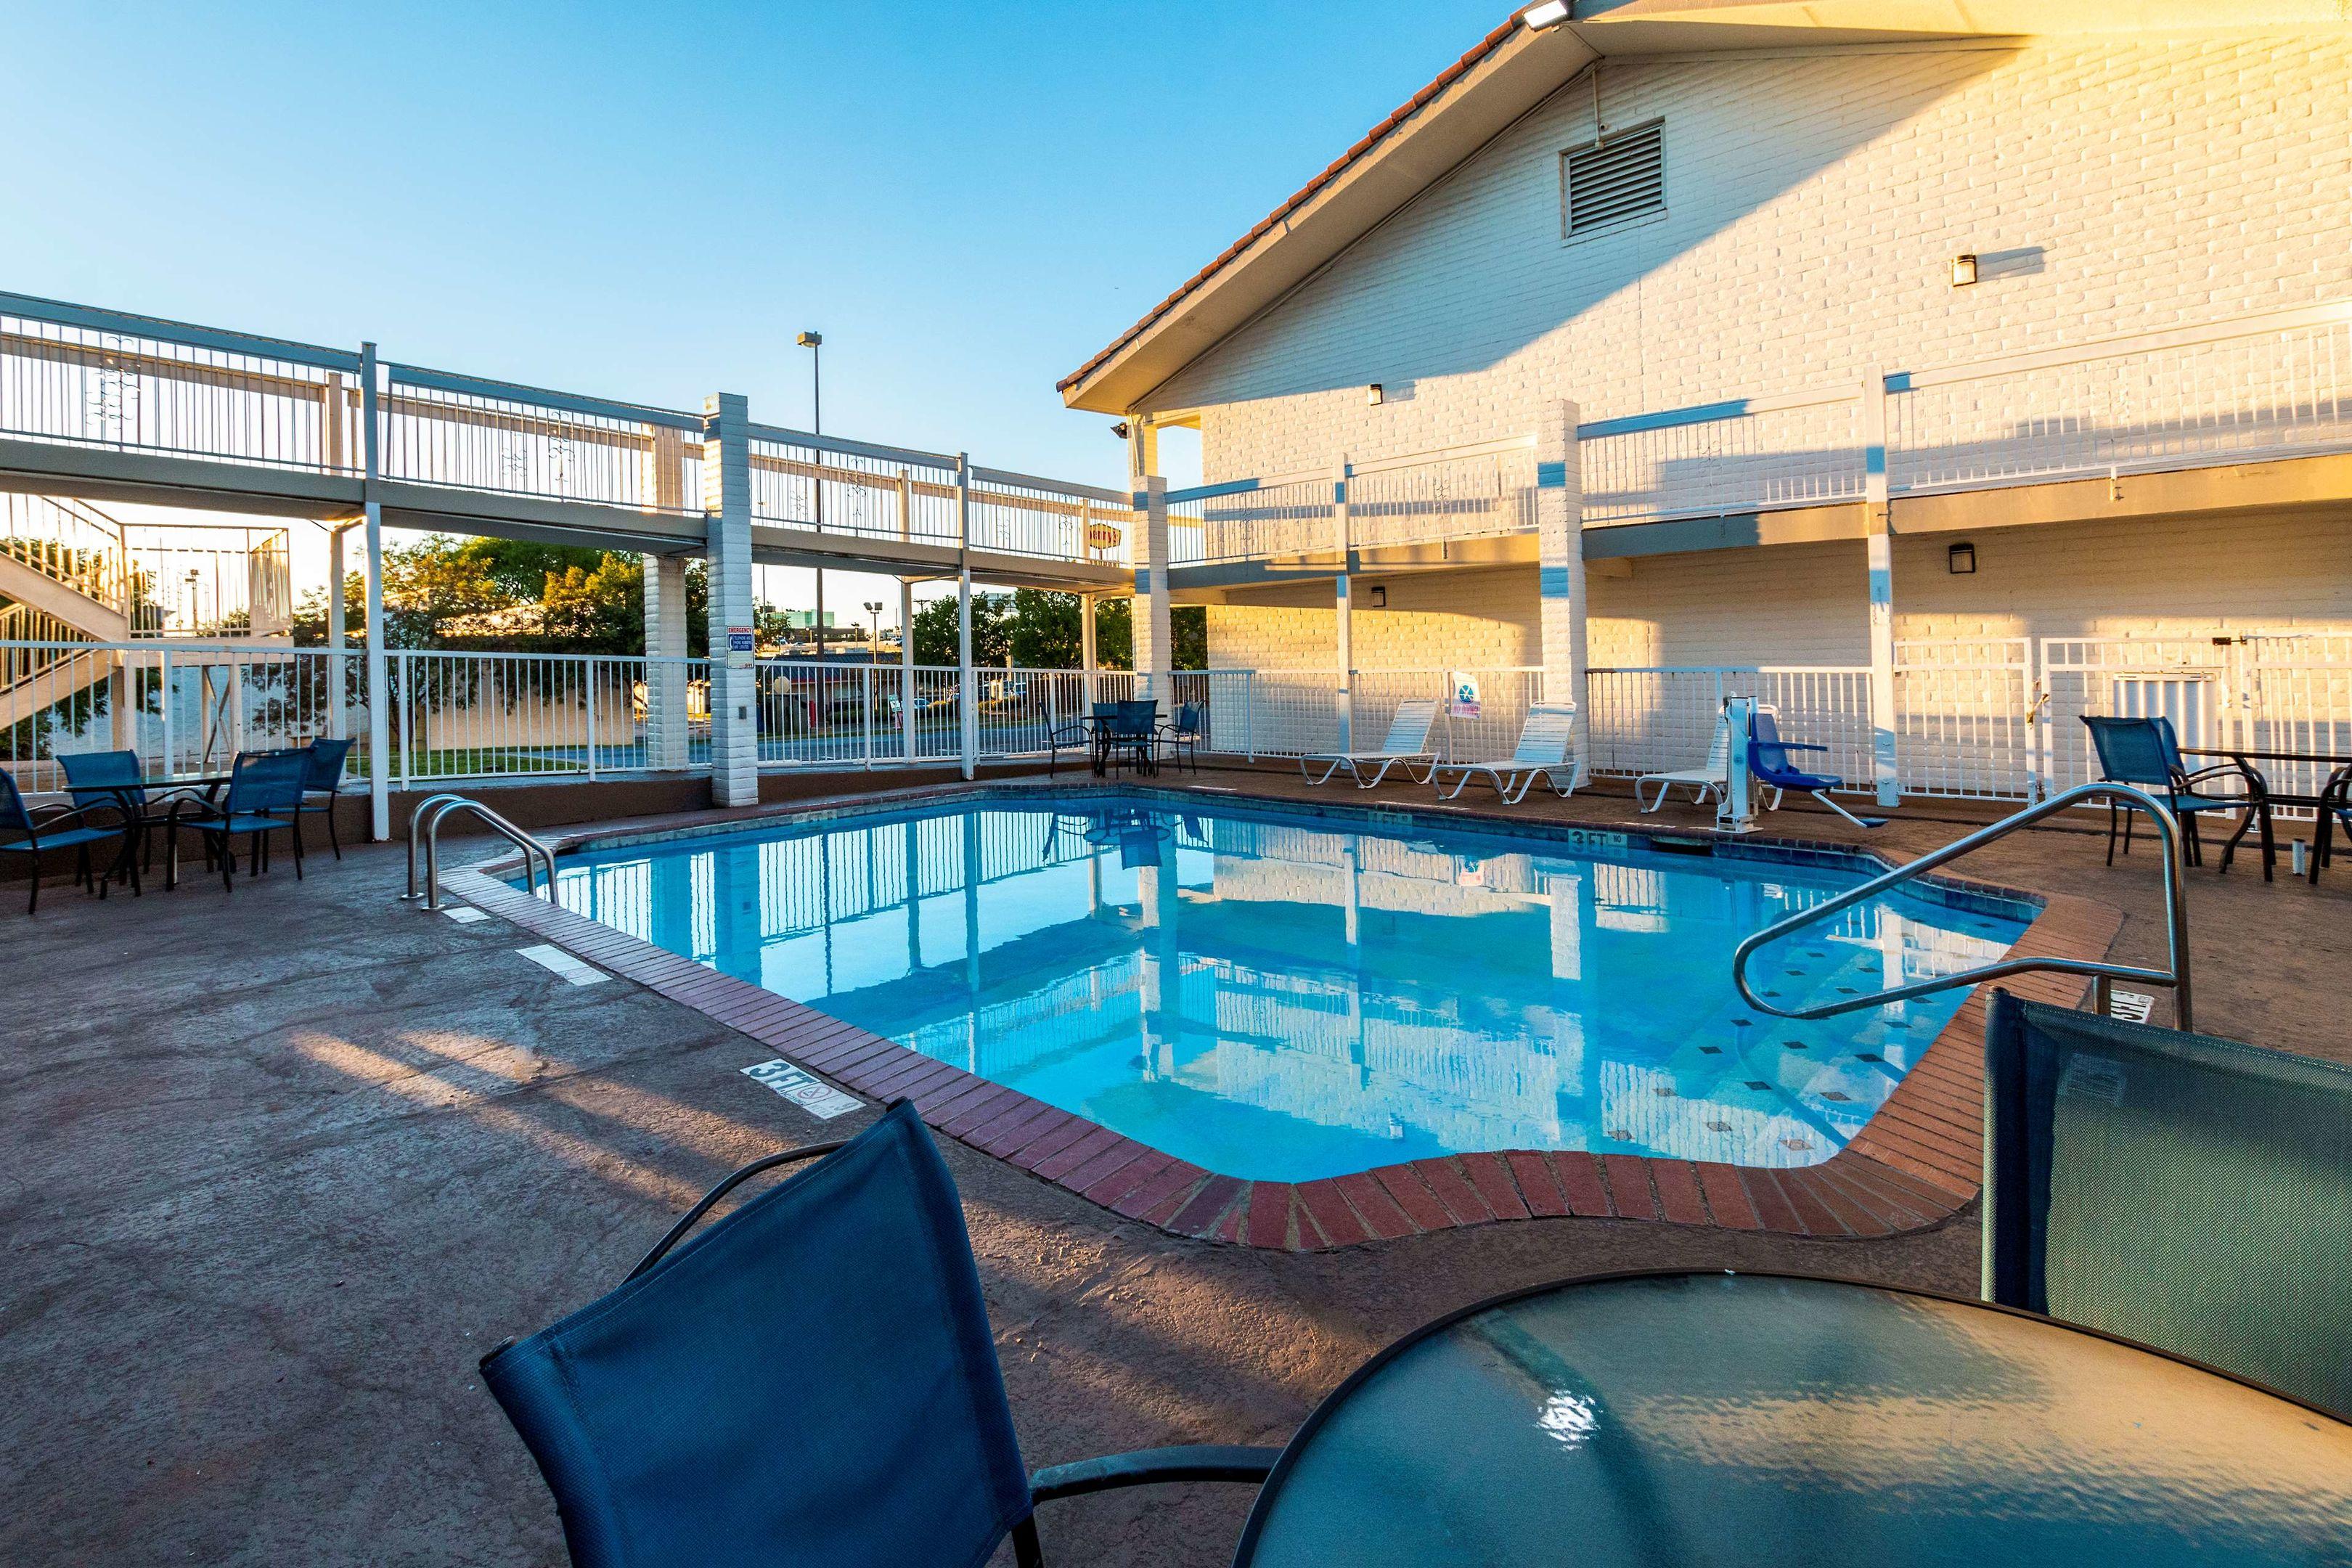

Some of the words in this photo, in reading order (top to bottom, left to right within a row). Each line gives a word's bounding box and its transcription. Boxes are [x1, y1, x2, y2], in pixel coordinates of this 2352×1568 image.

[1453, 705, 1461, 714] NO
[1588, 833, 1606, 846] FT
[1613, 834, 1622, 843] NO
[749, 1062, 791, 1078] 3
[764, 1070, 817, 1091] FT
